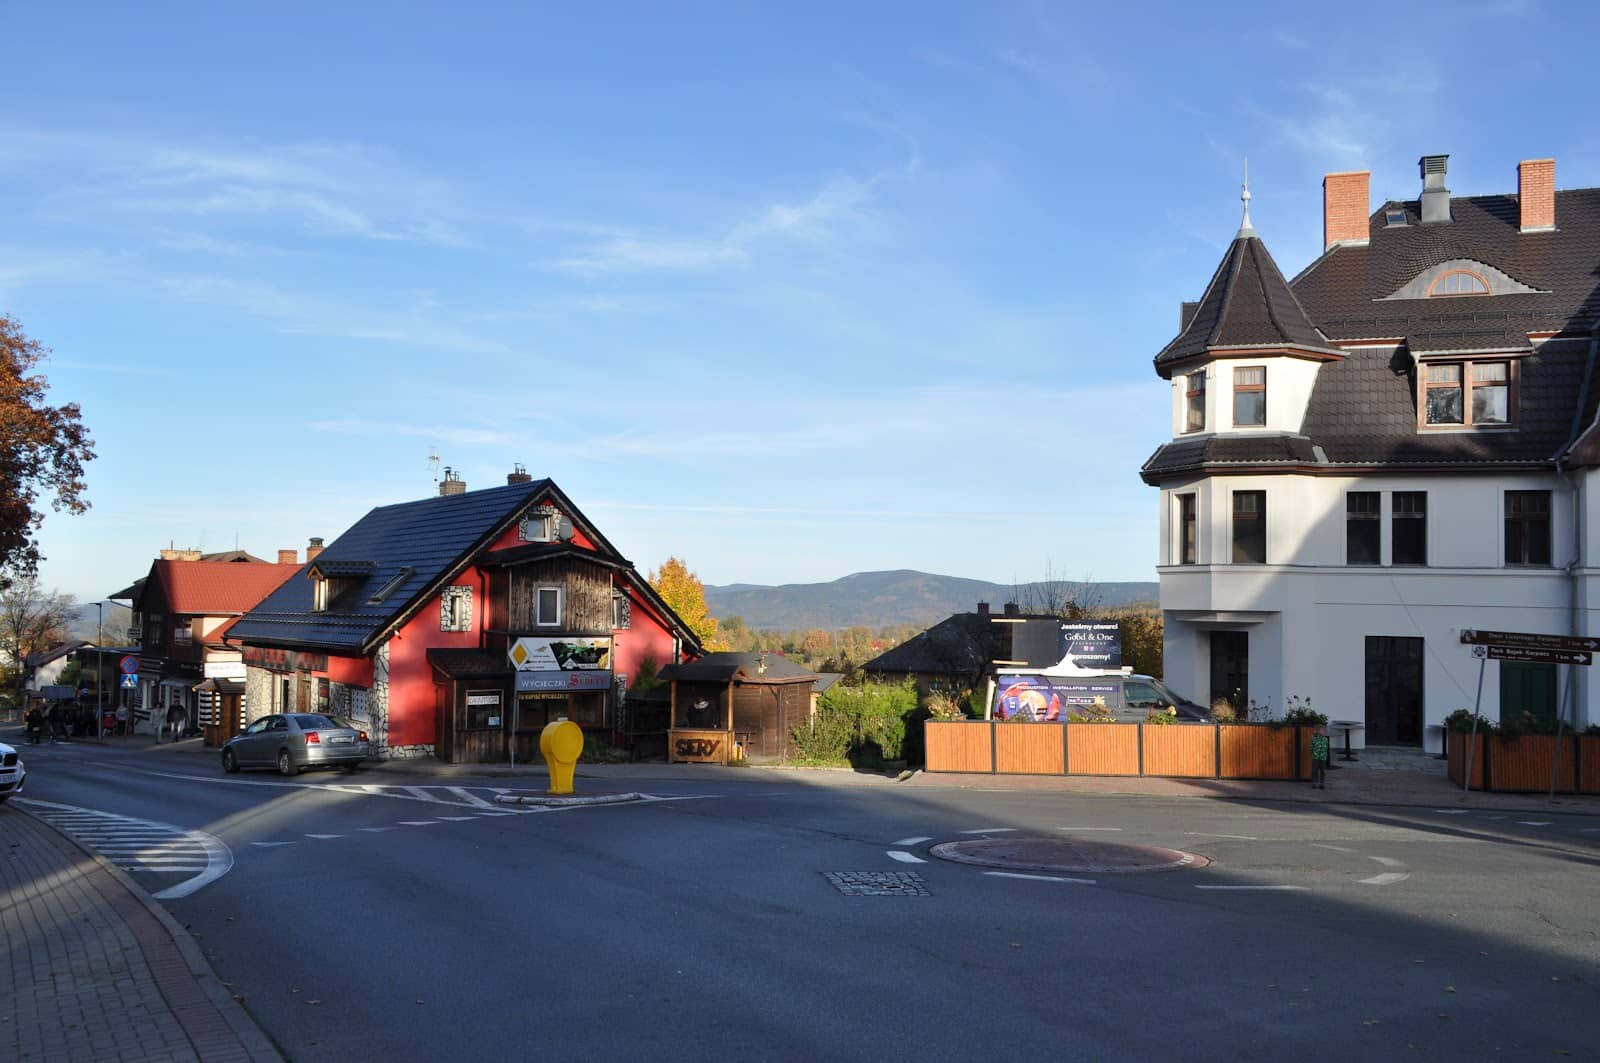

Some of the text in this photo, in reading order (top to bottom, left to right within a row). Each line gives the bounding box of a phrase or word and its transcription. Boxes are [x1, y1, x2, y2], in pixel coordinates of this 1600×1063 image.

[1061, 623, 1092, 631] Jesteśmy
[1064, 632, 1114, 641] Good & One
[521, 680, 566, 688] WYCIECZKI
[675, 738, 721, 756] SERY
